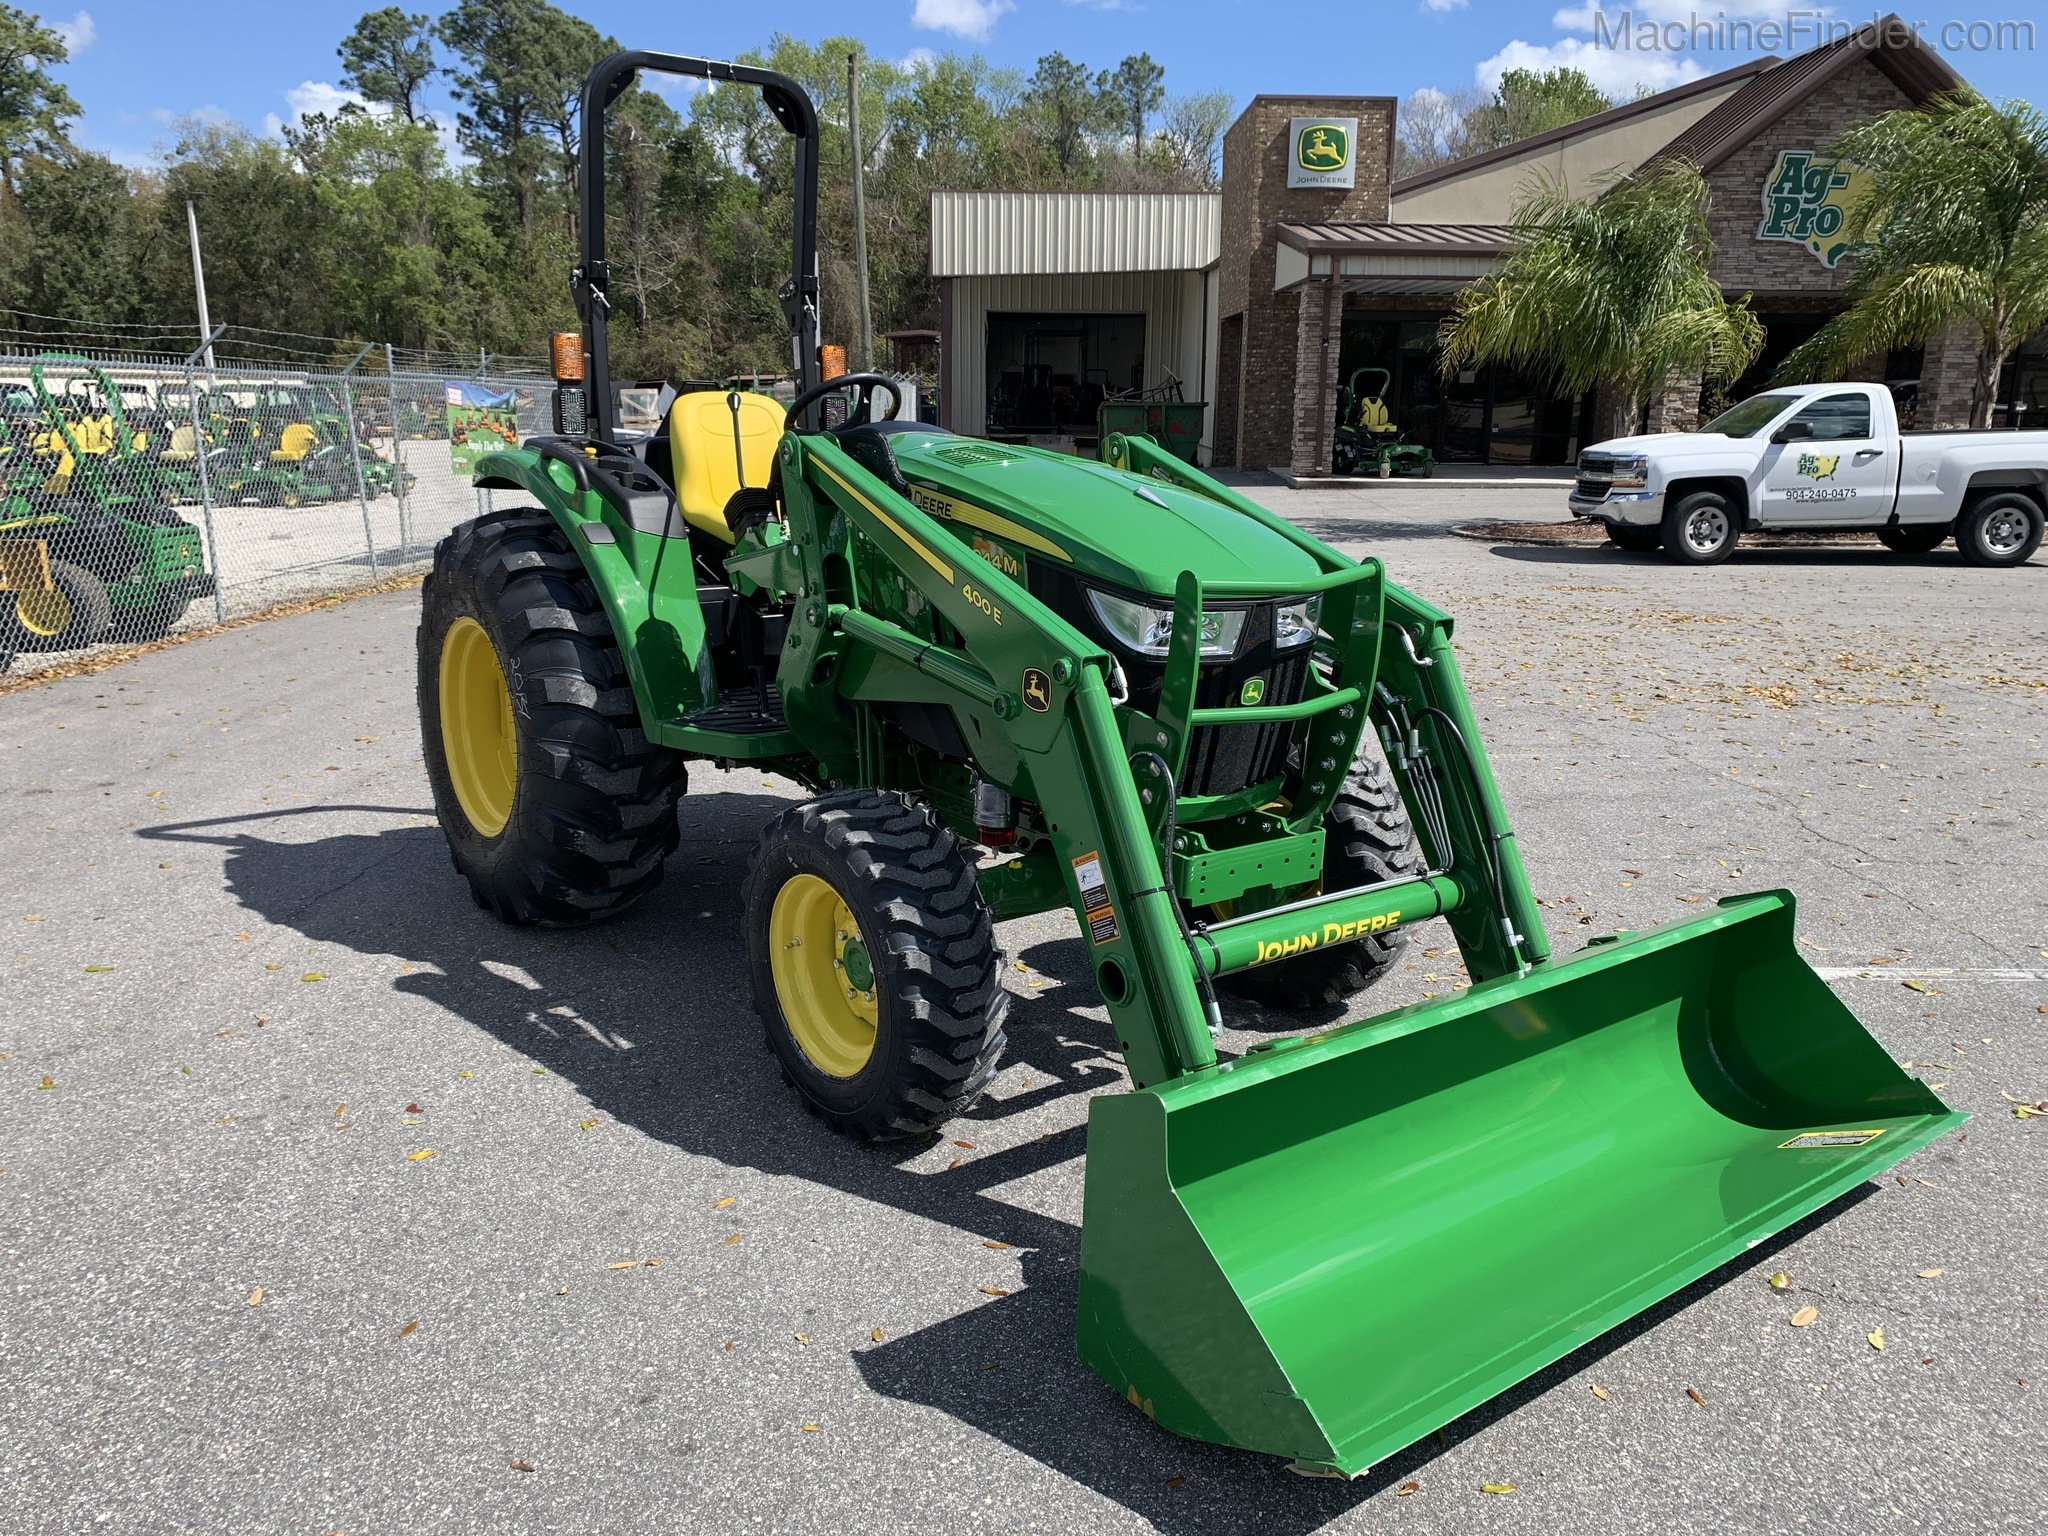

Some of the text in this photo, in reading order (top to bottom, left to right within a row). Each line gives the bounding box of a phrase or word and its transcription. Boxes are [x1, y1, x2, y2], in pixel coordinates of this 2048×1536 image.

[1296, 175, 1347, 184] JOHN DEERE
[1768, 153, 1851, 206] Ag-
[1761, 196, 1843, 238] Pro
[1799, 454, 1819, 465] Ag-
[1799, 464, 1819, 474] Pro
[914, 490, 952, 517] DEERE
[1786, 489, 1856, 500] 904-240-0475
[962, 584, 1002, 627] 400 E
[1248, 910, 1400, 966] JOHN DEERE
